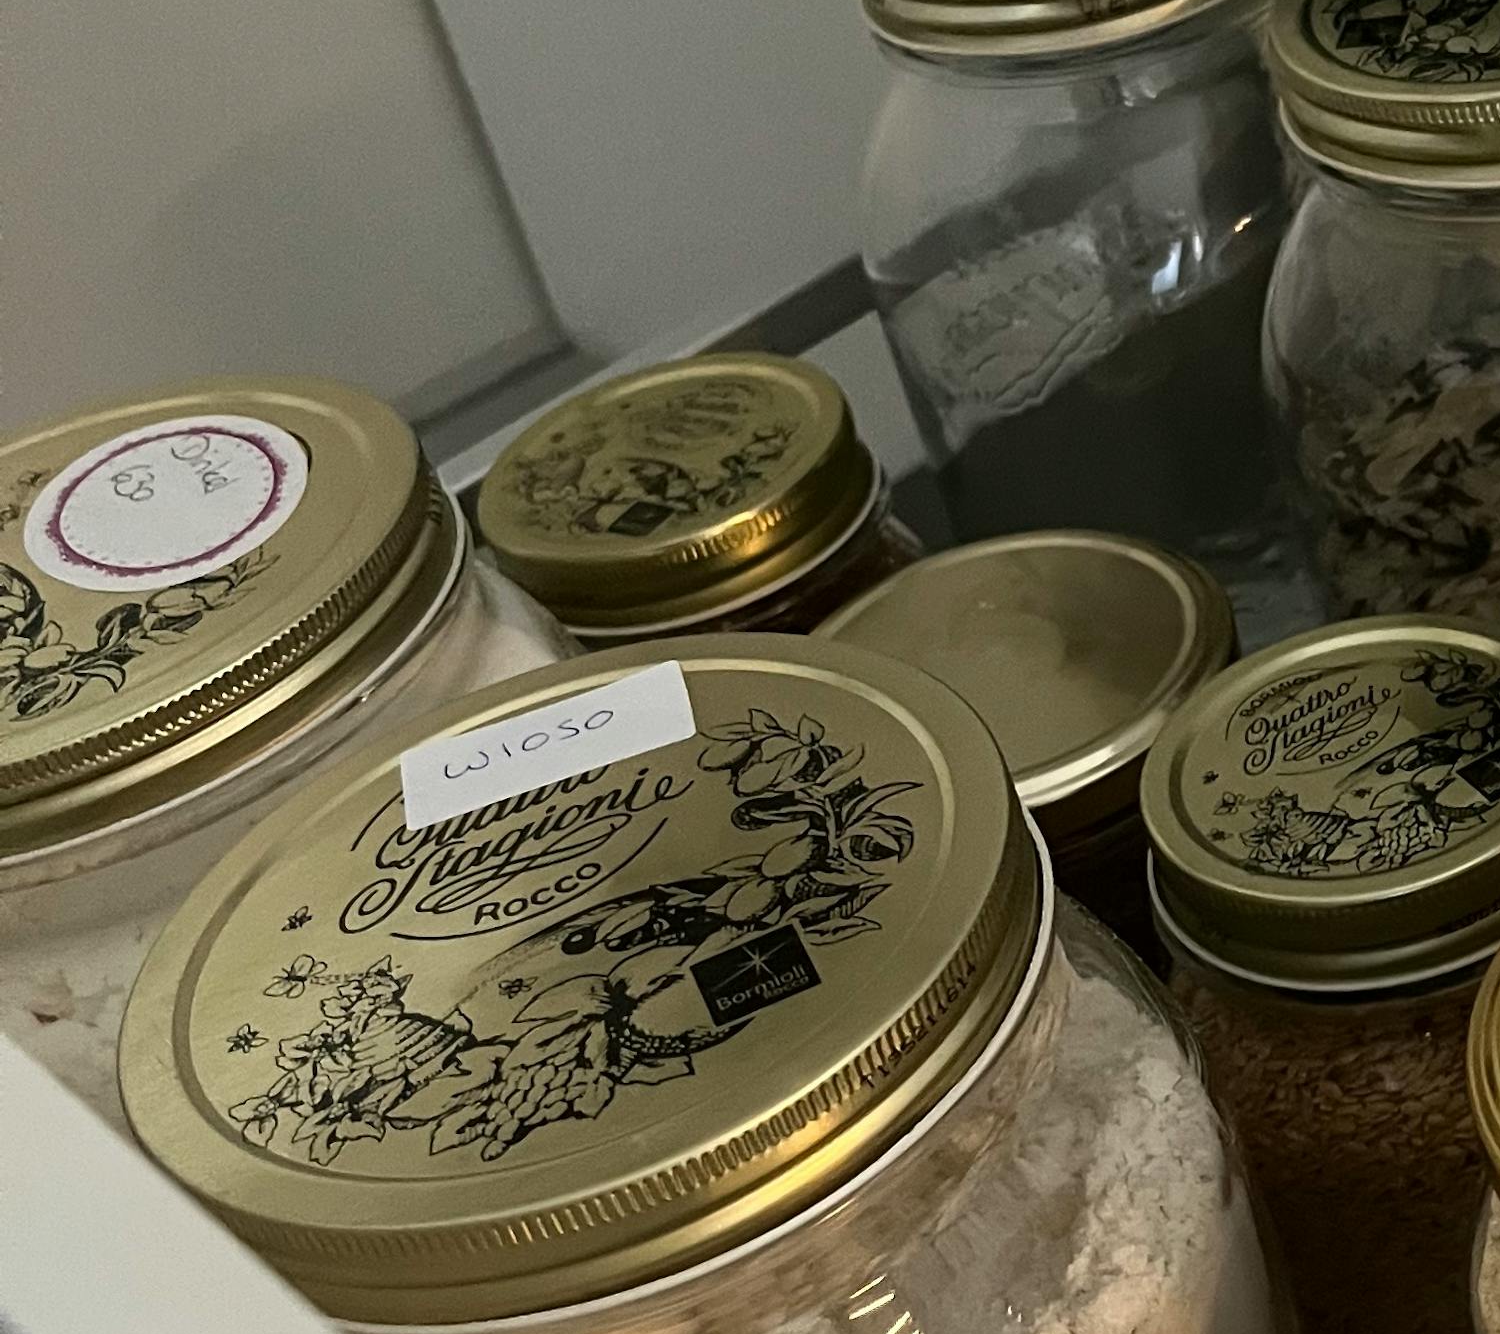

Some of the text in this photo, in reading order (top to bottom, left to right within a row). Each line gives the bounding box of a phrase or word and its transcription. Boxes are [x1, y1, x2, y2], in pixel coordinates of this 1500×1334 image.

[1245, 675, 1358, 745] Quattro
[1319, 729, 1379, 765] ROCCO
[474, 862, 601, 926] ROCCO
[715, 963, 806, 1011] Bormioli
